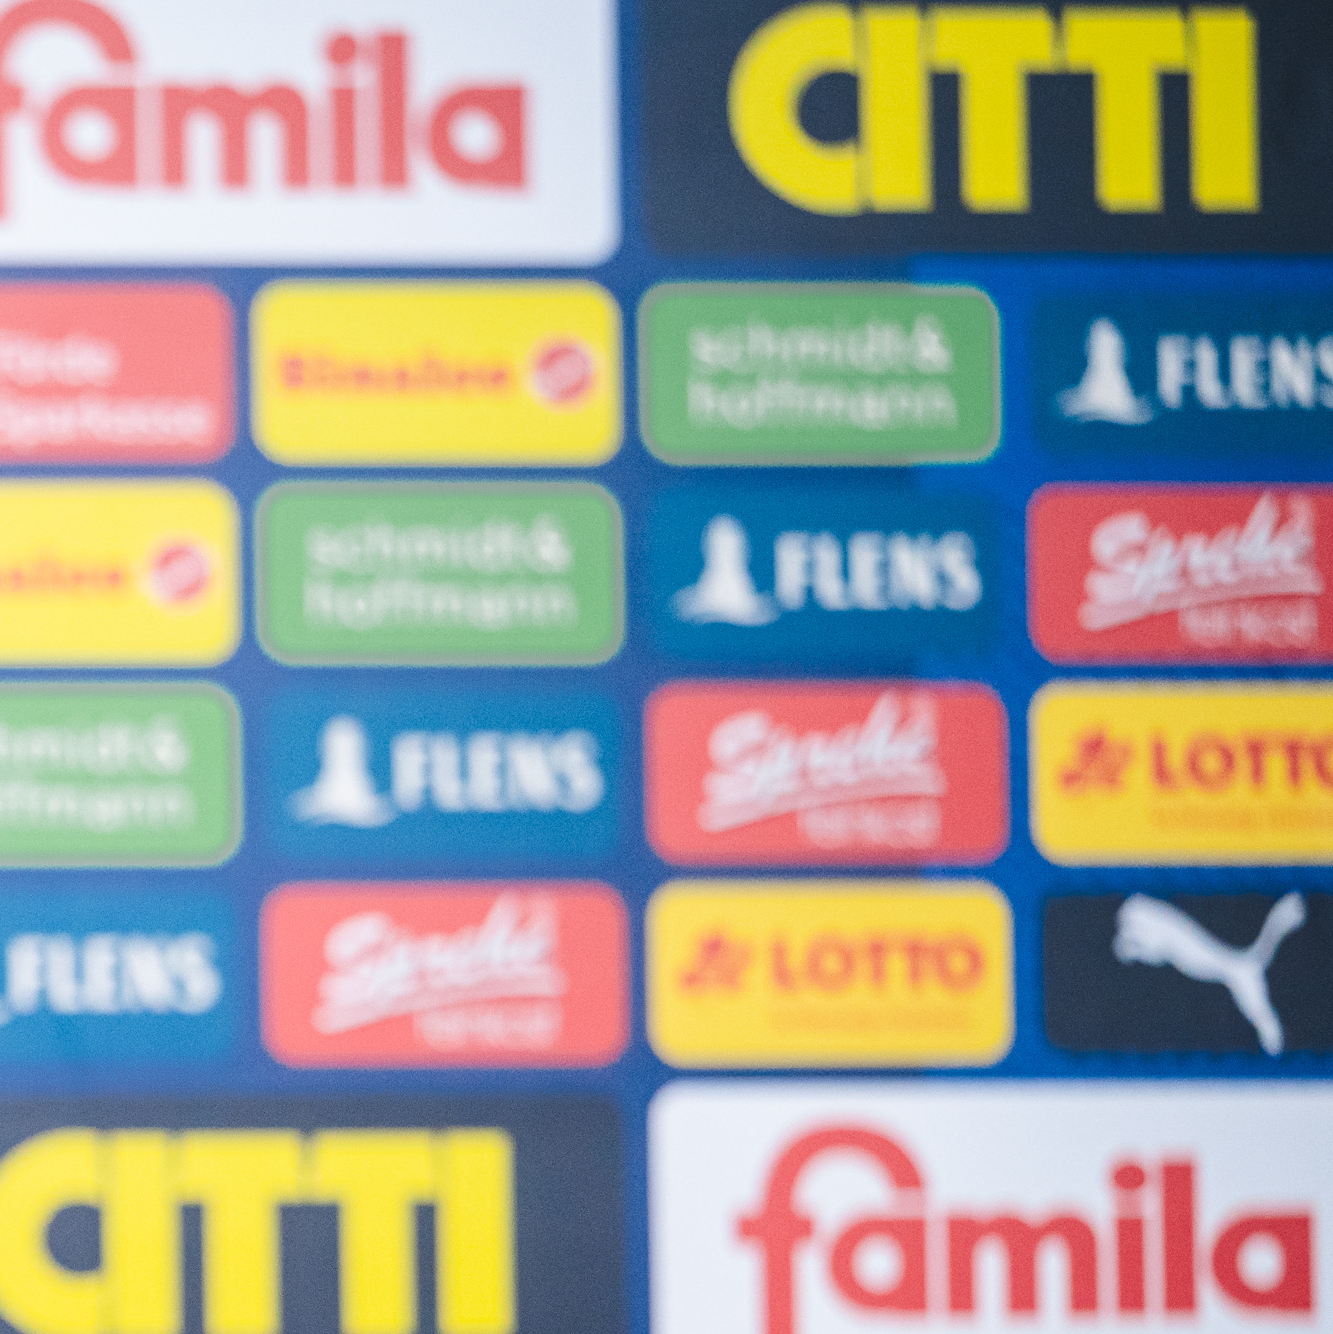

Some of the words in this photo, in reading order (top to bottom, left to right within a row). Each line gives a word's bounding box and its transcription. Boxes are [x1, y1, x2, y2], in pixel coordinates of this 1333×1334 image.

[727, 4, 1260, 216] CITTI
[774, 530, 982, 612] FLENS
[390, 729, 605, 814] FLENS
[6, 931, 222, 1016] FLENS
[770, 926, 984, 992] LOTTO
